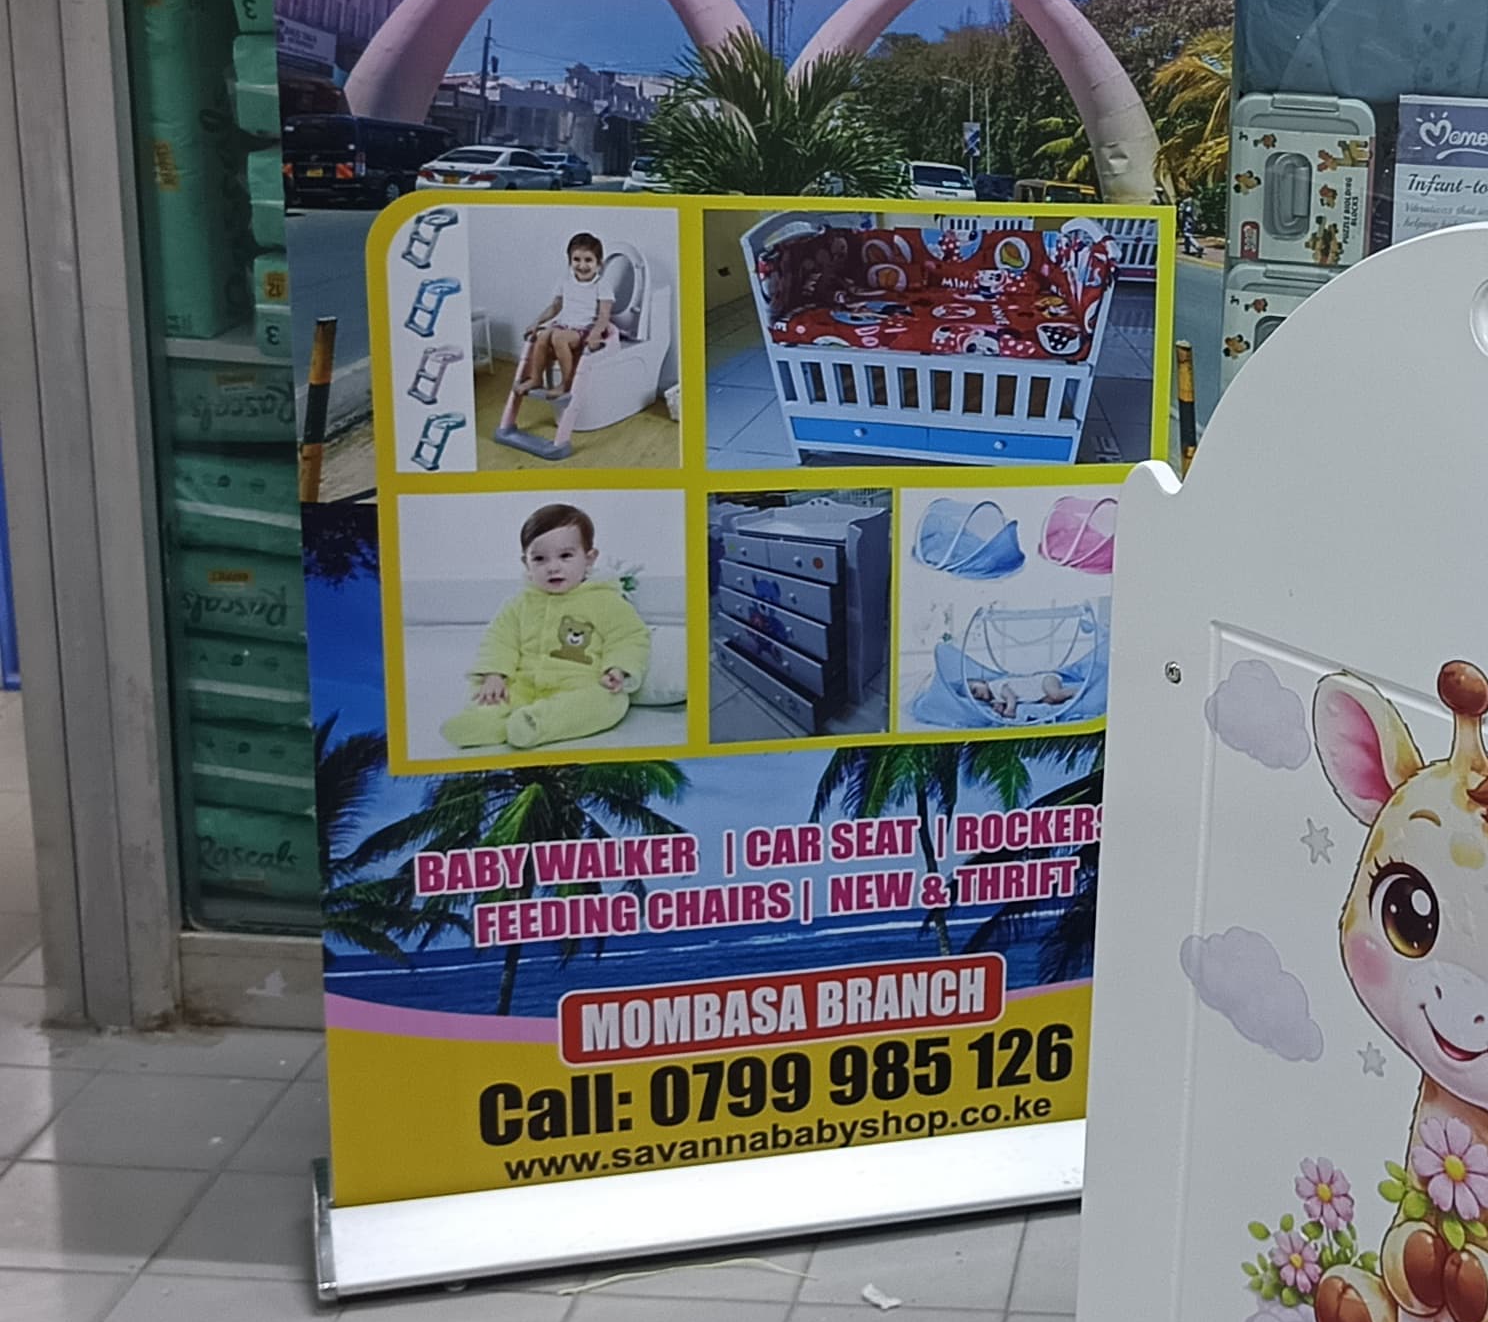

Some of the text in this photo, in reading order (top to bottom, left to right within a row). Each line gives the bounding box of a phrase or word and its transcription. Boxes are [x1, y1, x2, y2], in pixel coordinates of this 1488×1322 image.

[415, 847, 525, 896] BABY
[534, 835, 698, 884] WALKER
[744, 824, 823, 870] CAR
[830, 818, 922, 862] SEAT
[474, 859, 1081, 946] FEEDING CHAIRS NEW & THRIFT
[580, 967, 987, 1053] MOMBASA BRANCH
[478, 1023, 1075, 1147] Call: 0799 985 126
[504, 1094, 1053, 1183] www.savannababyshop.co.ke
